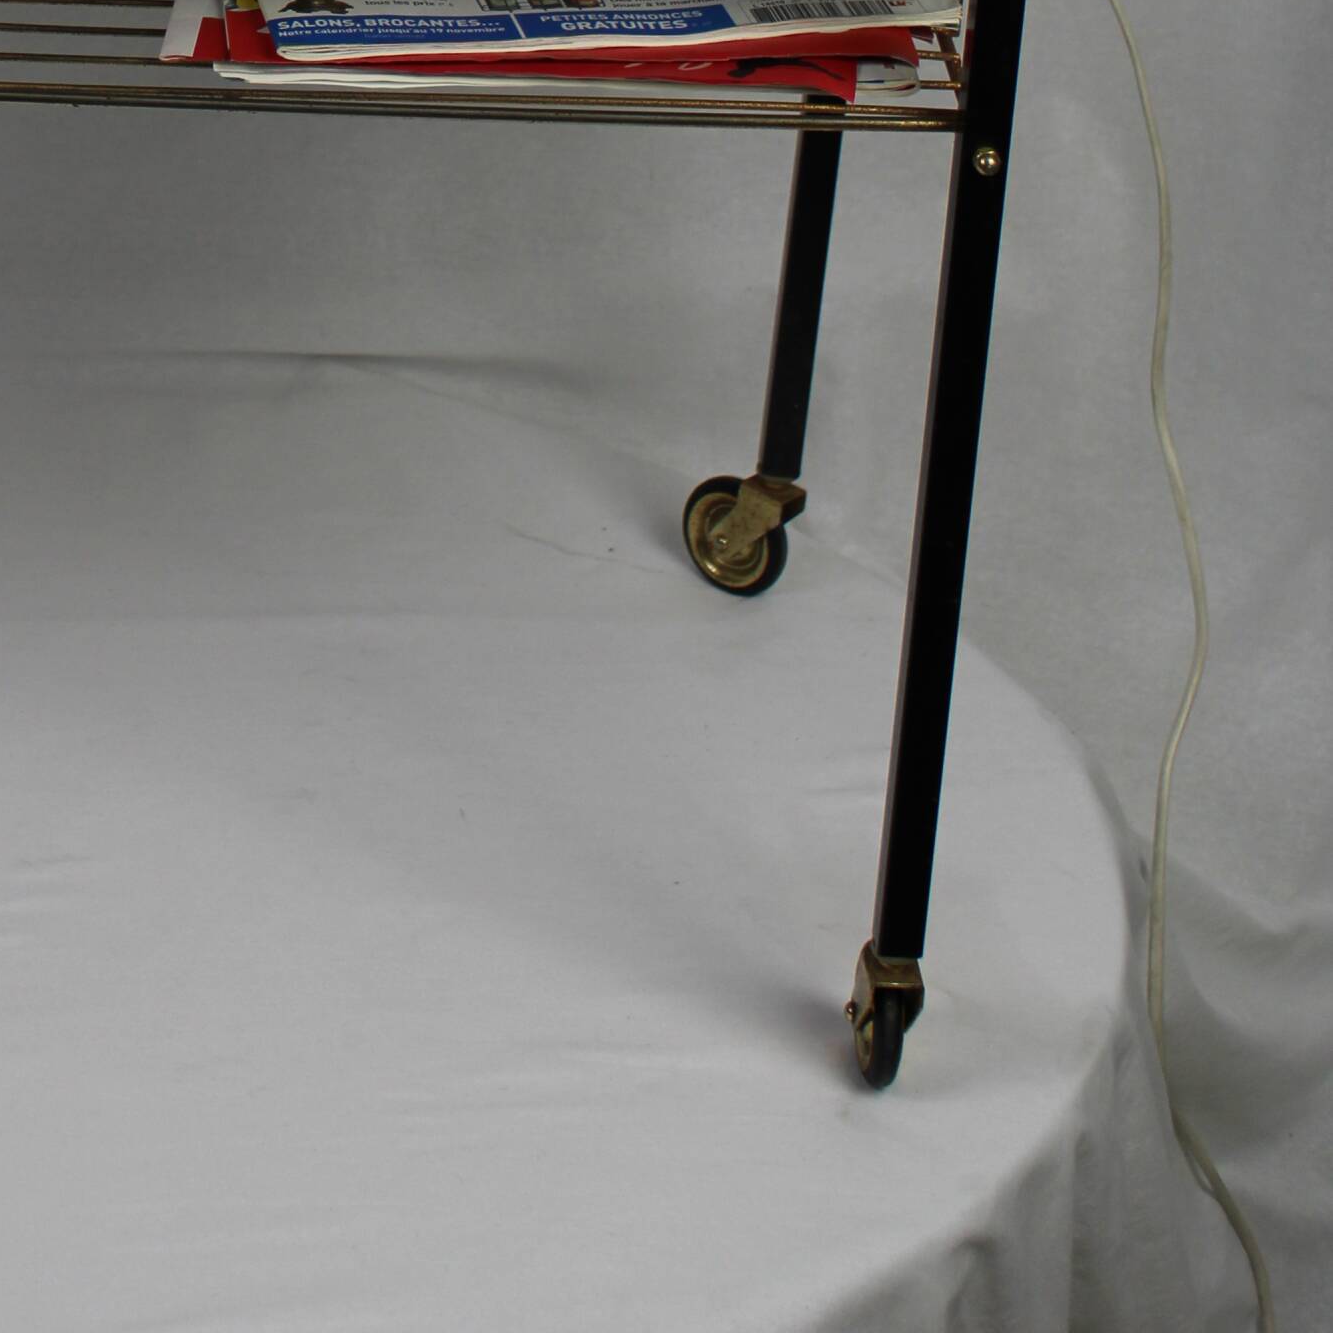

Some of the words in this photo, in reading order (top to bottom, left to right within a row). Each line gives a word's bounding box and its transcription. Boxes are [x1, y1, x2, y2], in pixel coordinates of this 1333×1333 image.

[539, 14, 608, 22] PETITES
[611, 9, 703, 21] ANNONCES
[277, 18, 363, 30] SALONS,
[364, 17, 501, 28] BROCANTES...
[560, 19, 688, 31] GRATUITES
[278, 28, 311, 37] Notre
[314, 27, 374, 35] calendrier
[446, 26, 505, 34] novembre
